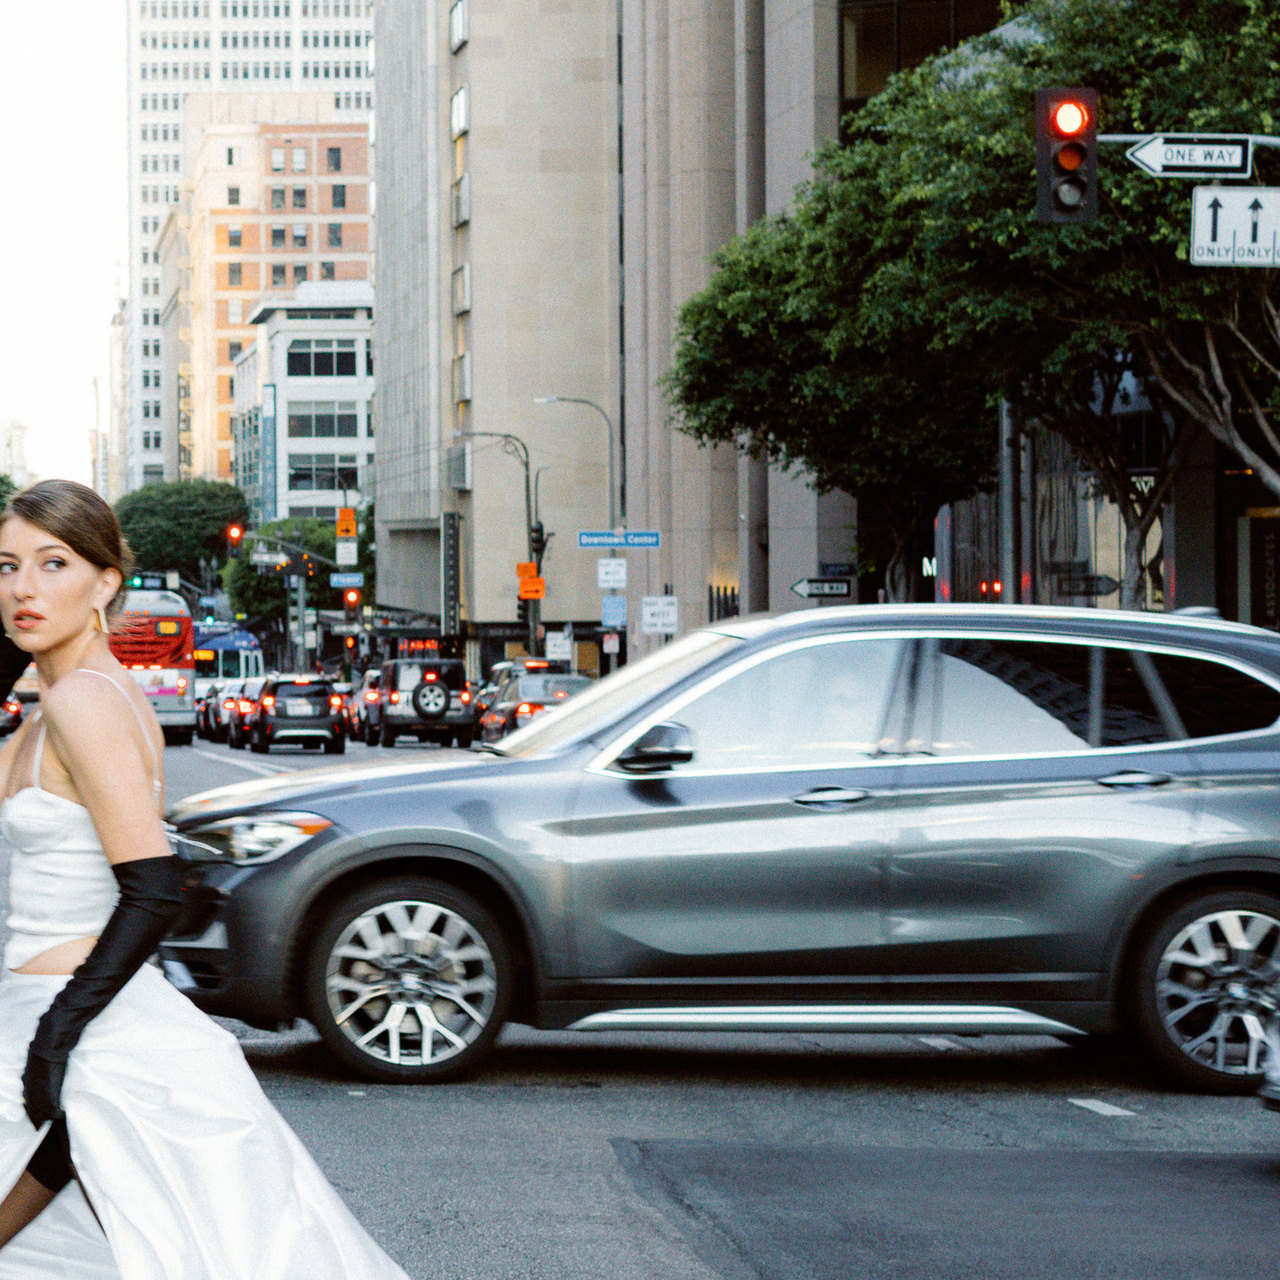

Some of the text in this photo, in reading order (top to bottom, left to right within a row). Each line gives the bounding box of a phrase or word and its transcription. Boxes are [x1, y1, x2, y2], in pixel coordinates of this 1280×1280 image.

[1164, 147, 1236, 163] ONE WAY
[1196, 246, 1230, 257] ONLY
[1237, 247, 1270, 258] ONLY
